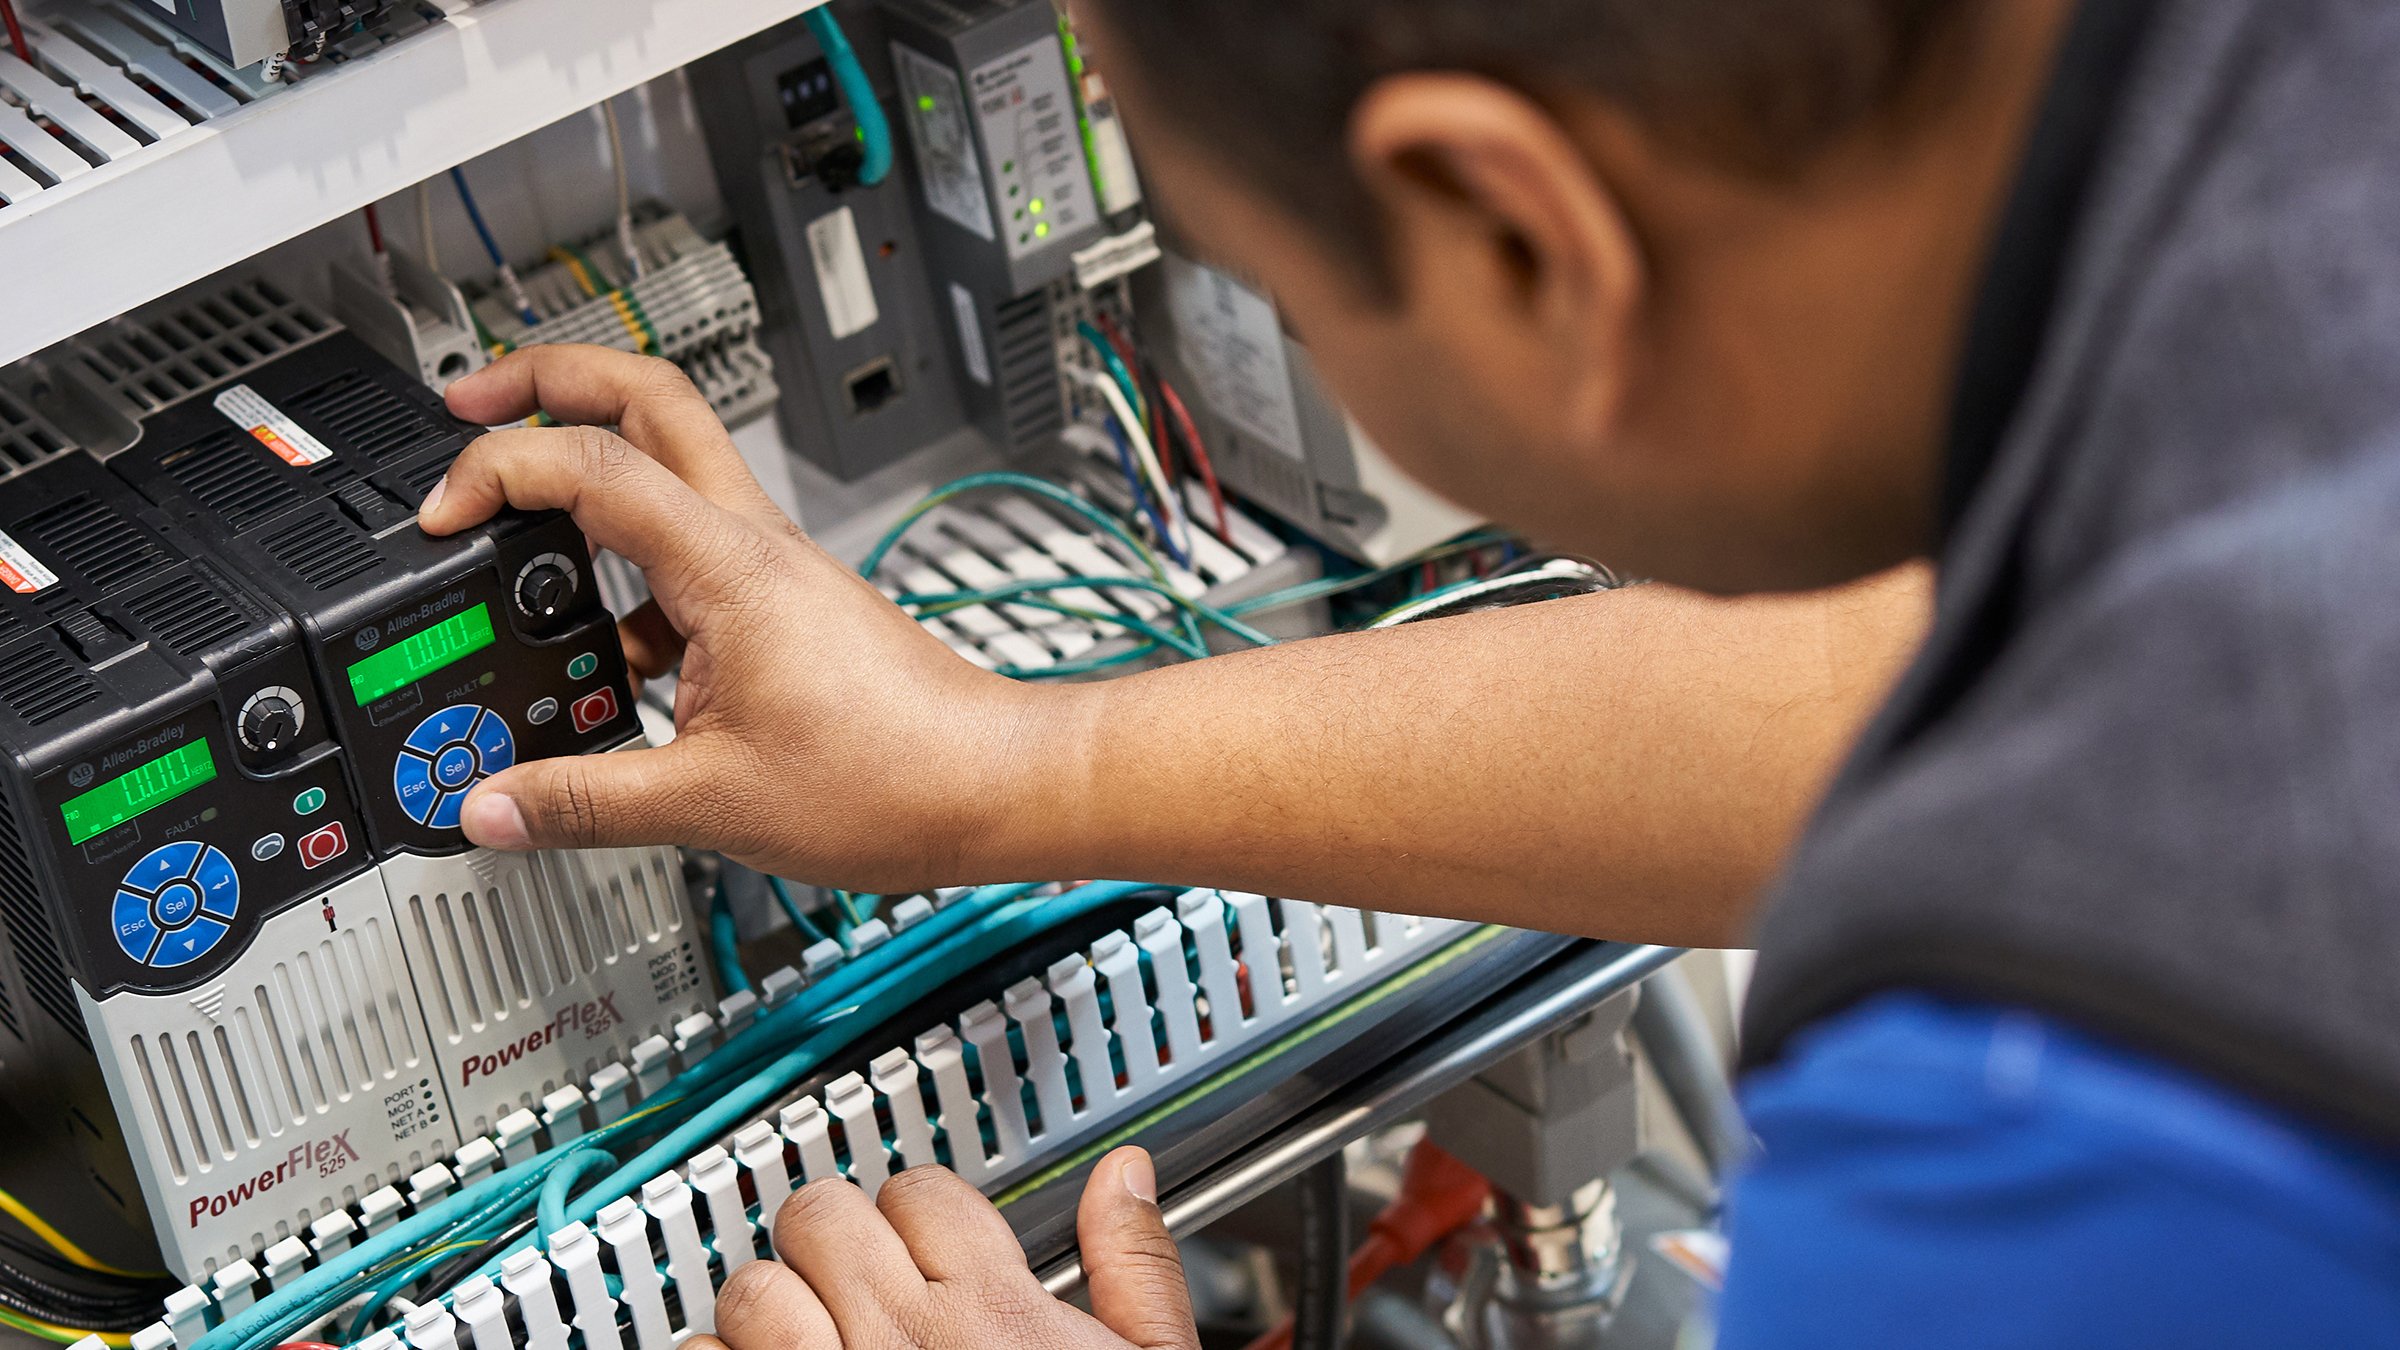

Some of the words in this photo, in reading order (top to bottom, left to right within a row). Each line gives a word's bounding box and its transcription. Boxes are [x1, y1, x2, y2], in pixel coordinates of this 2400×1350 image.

[387, 589, 466, 636] Allen-Bradley
[469, 625, 490, 641] HERTZ
[446, 679, 479, 701] FAULT
[101, 723, 185, 772] Allen-Bradley
[190, 760, 212, 776] HERTZ
[445, 759, 465, 776] Sel
[402, 780, 427, 797] Esc
[165, 815, 199, 838] FAULT
[165, 896, 188, 914] Sel
[120, 919, 146, 936] Esc
[648, 947, 677, 968] PORT
[651, 962, 677, 980] MOD
[585, 1016, 611, 1040] 525
[384, 1084, 414, 1107] PORT
[388, 1099, 414, 1118] MOD
[391, 1112, 413, 1130] NET
[417, 1108, 426, 1118] A
[395, 1124, 416, 1141] NET
[419, 1120, 428, 1130] B
[319, 1154, 346, 1179] 525
